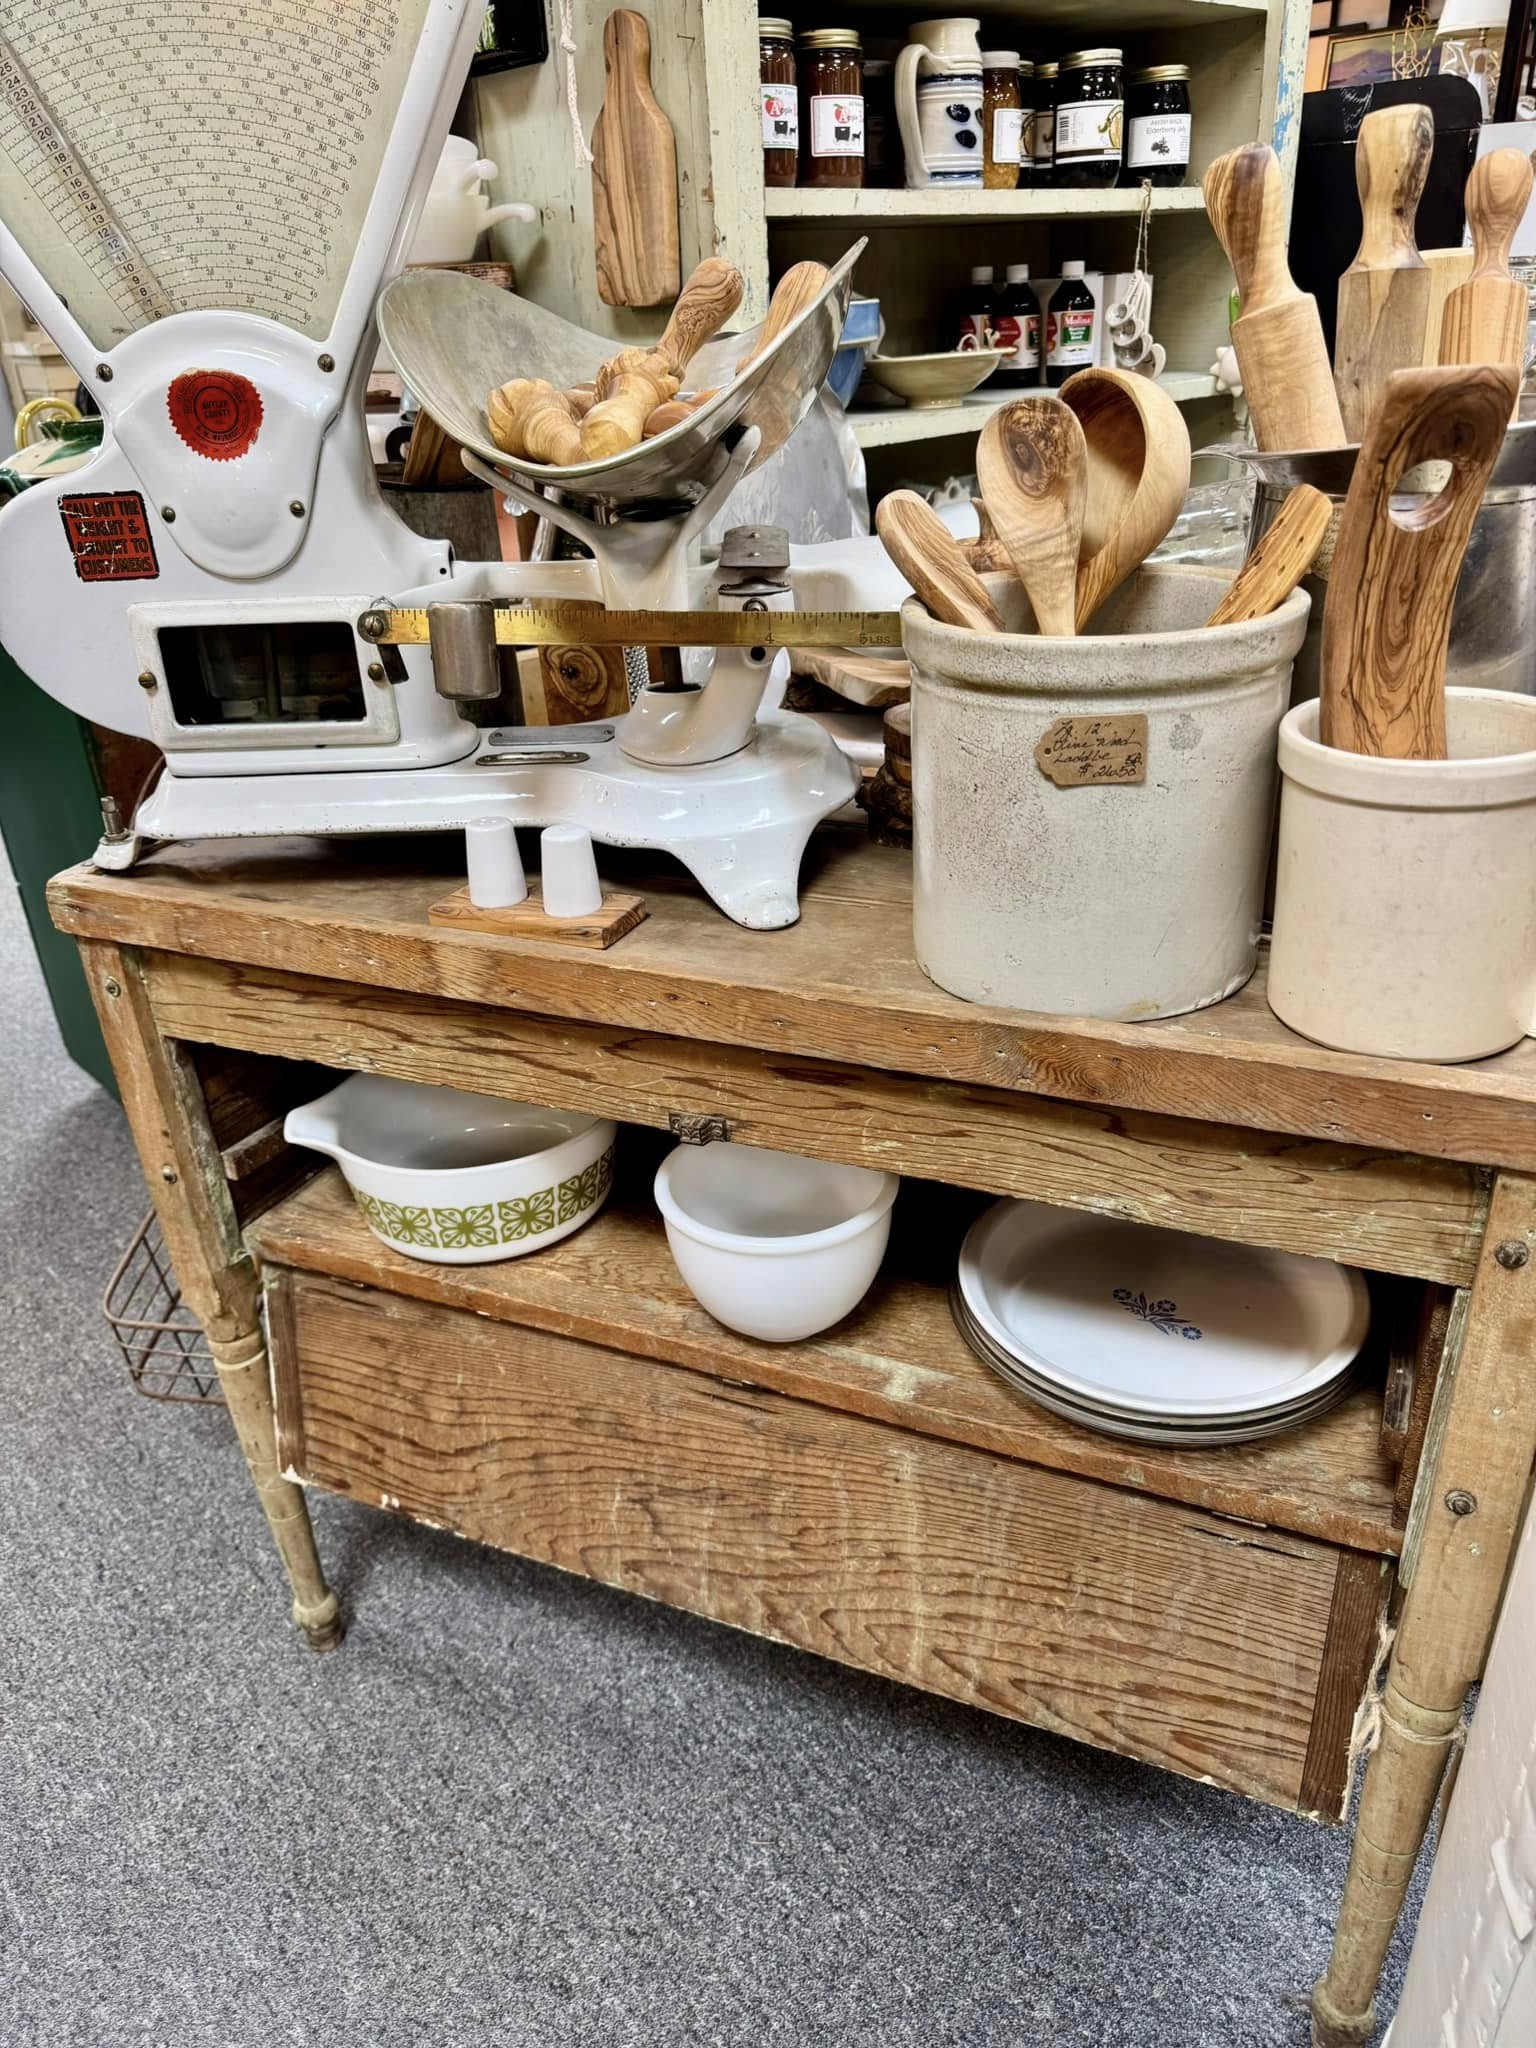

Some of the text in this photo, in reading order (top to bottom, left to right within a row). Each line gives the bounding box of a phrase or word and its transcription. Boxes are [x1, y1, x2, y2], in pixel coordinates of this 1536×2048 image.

[296, 6, 306, 16] 110
[327, 16, 338, 27] 120
[164, 3, 172, 11] 70
[201, 4, 209, 12] 80
[307, 25, 318, 35] 110
[337, 35, 347, 46] 120
[200, 34, 208, 42] 70
[311, 55, 321, 66] 100
[368, 81, 379, 91] 120
[331, 48, 341, 58] 110
[359, 60, 370, 71] 120
[6, 76, 20, 89] 24
[241, 80, 249, 88] 70
[322, 73, 332, 83] 100
[14, 88, 28, 101] 23
[333, 92, 343, 103] 100
[21, 101, 36, 114] 22
[29, 115, 44, 127] 21
[328, 119, 336, 127] 90
[37, 127, 52, 140] 20
[282, 131, 291, 140] 70
[46, 140, 59, 152] 19
[54, 152, 67, 164] 18
[296, 149, 305, 158] 70
[62, 165, 73, 177] 17
[310, 168, 318, 177] 70
[70, 178, 82, 190] 16
[78, 190, 90, 202] 15
[85, 202, 97, 214] 14
[92, 214, 105, 226] 13
[98, 227, 110, 239] 12
[108, 239, 120, 250] 12
[116, 251, 128, 262] 11
[123, 263, 135, 274] 10
[132, 275, 140, 285] 9
[139, 287, 148, 297] 8
[154, 310, 162, 319] 6
[66, 499, 140, 518] CALL OUT THE
[75, 518, 140, 537] WEIGHT &
[131, 538, 148, 553] TO
[81, 558, 153, 576] CUSTOMERS
[764, 632, 775, 644] 4
[859, 632, 868, 644] 5
[868, 635, 891, 644] LBS
